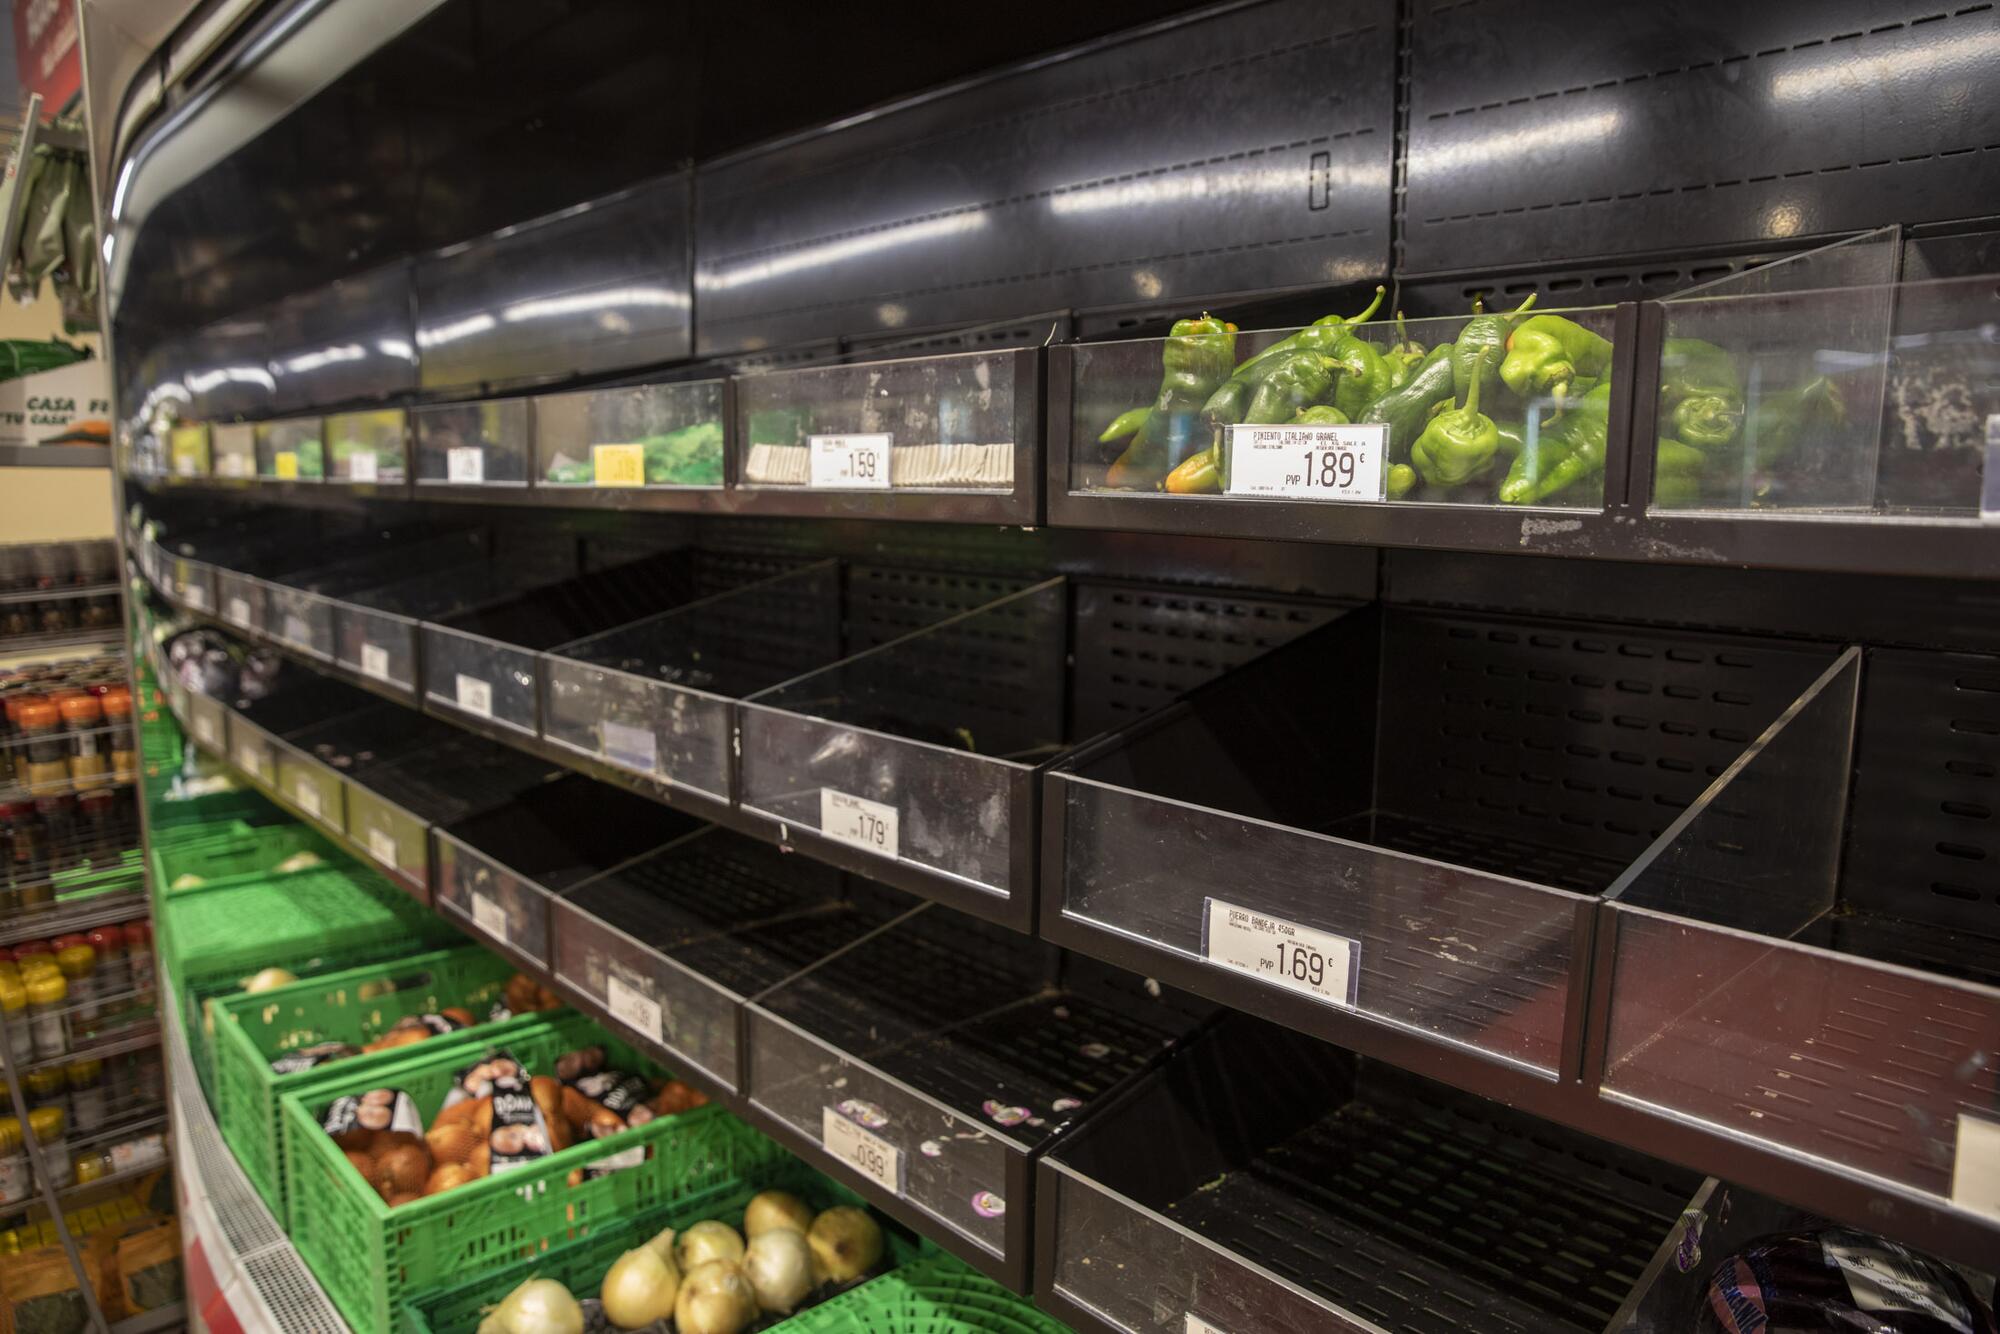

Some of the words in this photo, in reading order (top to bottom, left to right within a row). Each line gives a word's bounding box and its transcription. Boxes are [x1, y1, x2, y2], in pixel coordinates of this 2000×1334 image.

[27, 397, 75, 412] CASA
[1253, 431, 1282, 441] PIMIENTO
[1285, 431, 1313, 441] ITALIANO
[1315, 431, 1339, 442] GRANEL
[1286, 474, 1301, 486] PVP
[1304, 451, 1355, 488] 1,89
[1229, 909, 1249, 923] PUERRO
[1251, 915, 1276, 930] BANDEJA
[1260, 957, 1275, 971] PVP
[1276, 942, 1324, 986] 1,69
